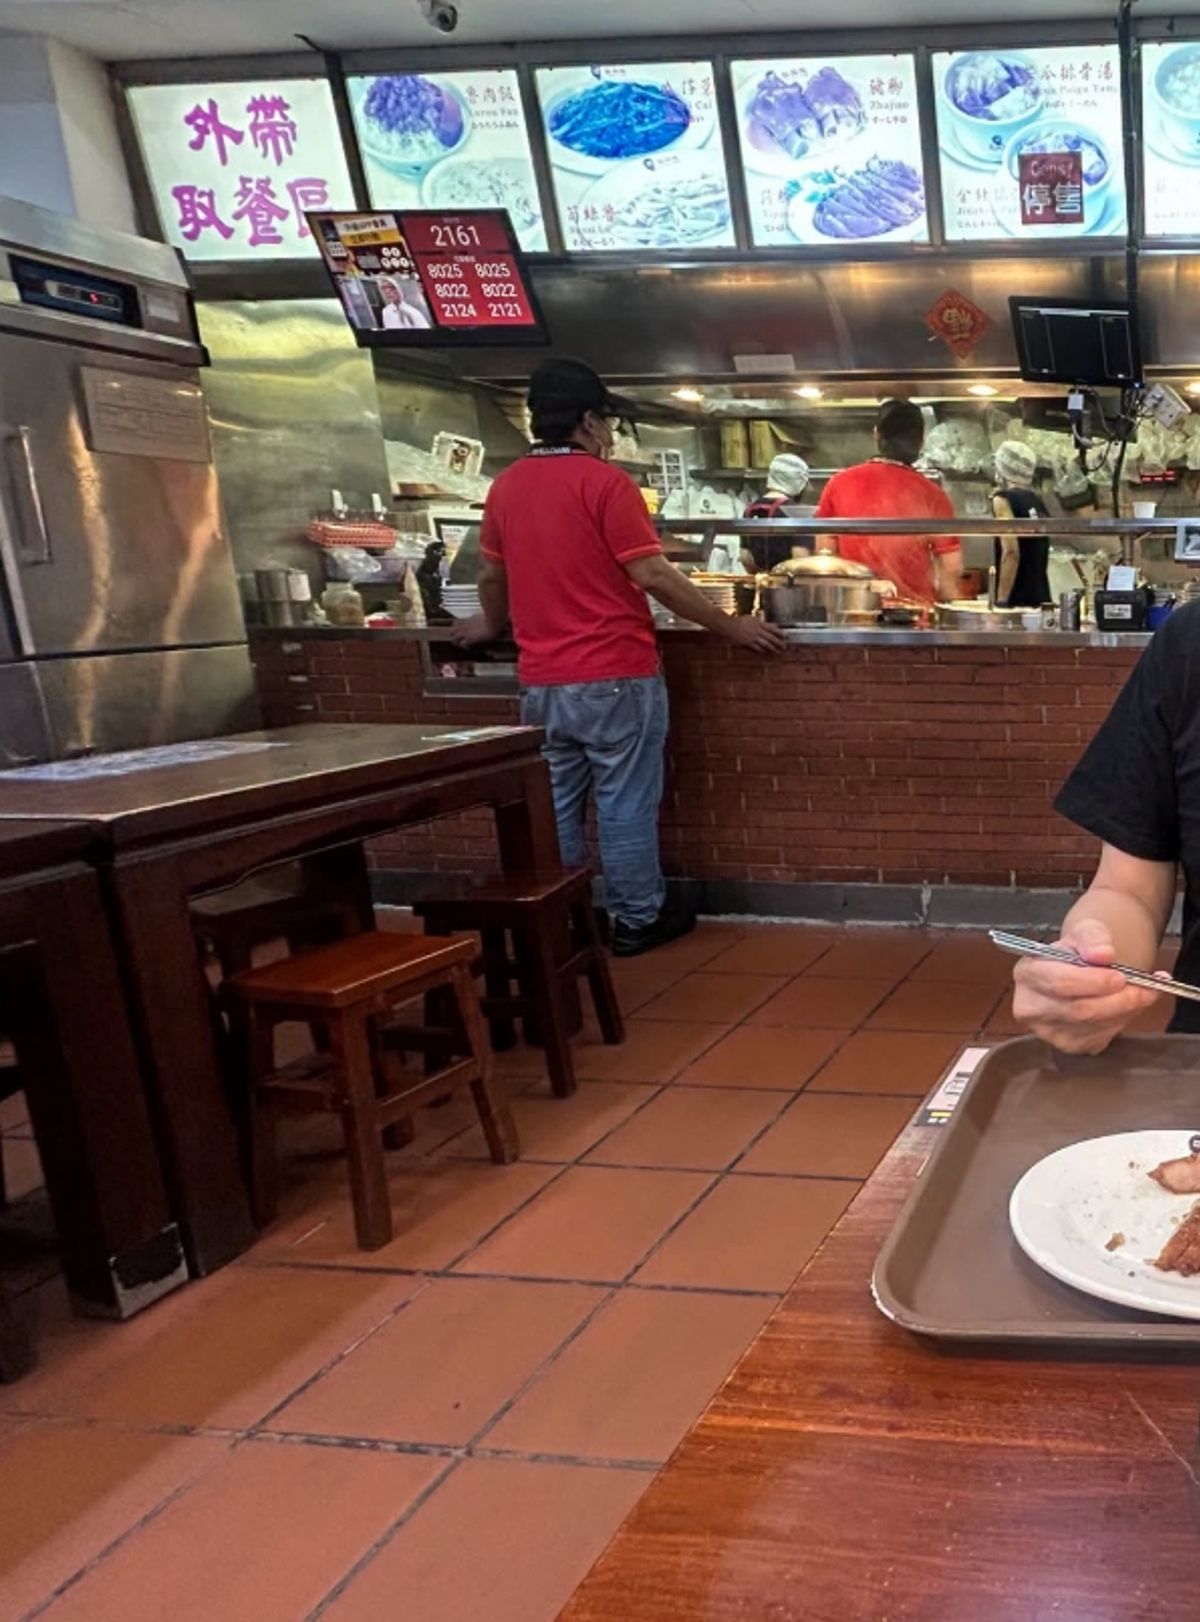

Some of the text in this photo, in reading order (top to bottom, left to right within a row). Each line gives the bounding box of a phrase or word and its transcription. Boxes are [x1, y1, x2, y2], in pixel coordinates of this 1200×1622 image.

[184, 94, 297, 166] 外帶
[1023, 181, 1081, 216] 停售
[430, 225, 480, 247] 2161
[426, 262, 511, 279] 8025 8025
[440, 302, 523, 318] 2124 2121
